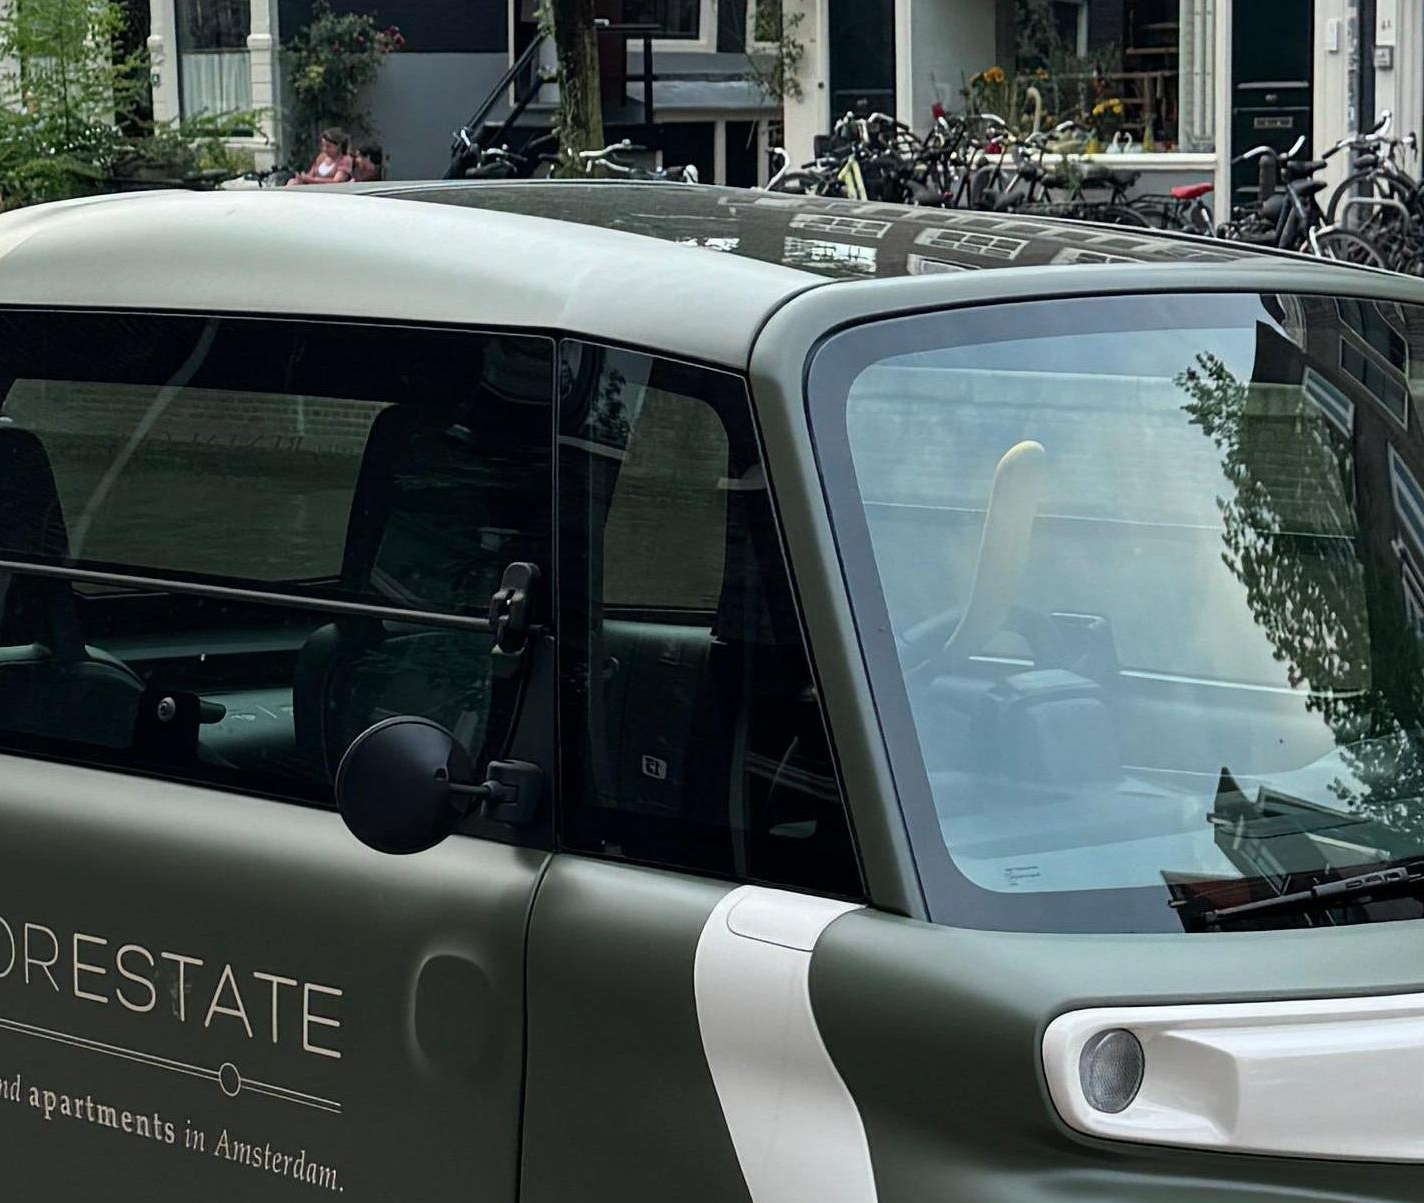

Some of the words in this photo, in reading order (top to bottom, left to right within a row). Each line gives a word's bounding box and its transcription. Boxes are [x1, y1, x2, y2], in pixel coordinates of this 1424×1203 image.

[28, 1087, 176, 1144] apartments
[185, 1119, 205, 1152] in
[213, 1129, 344, 1192] Amsterdam.
